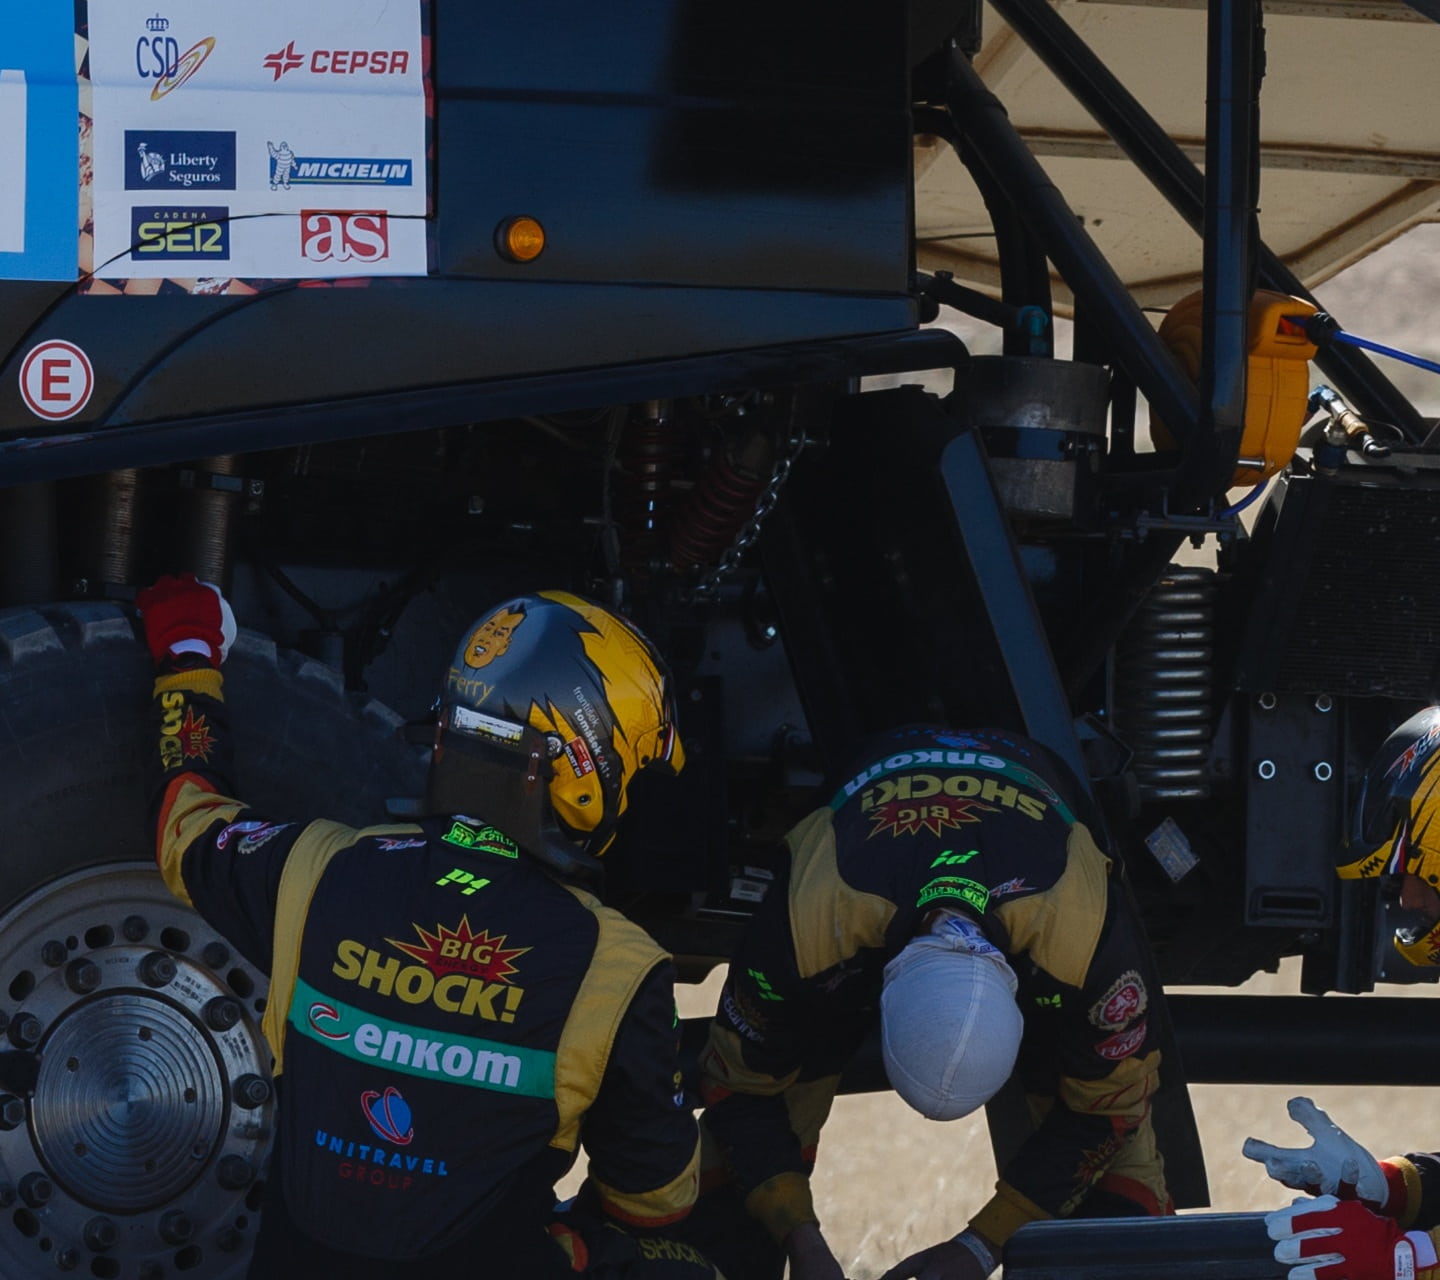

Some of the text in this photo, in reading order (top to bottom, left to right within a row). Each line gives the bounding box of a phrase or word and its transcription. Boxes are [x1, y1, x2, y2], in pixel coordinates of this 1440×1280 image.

[136, 35, 179, 79] CSD
[310, 50, 410, 75] CEPSA
[169, 152, 219, 170] Liberty
[297, 162, 408, 179] MICHELIN
[168, 169, 221, 187] Seguros
[153, 211, 207, 220] CADENA
[137, 222, 223, 253] SER
[305, 213, 386, 263] as
[41, 358, 72, 402] E
[860, 772, 1049, 822] SHOCK!
[896, 804, 951, 825] BIG
[439, 937, 495, 965] BIG
[332, 938, 526, 1025] SHOCK!
[353, 1022, 523, 1089] enkom
[314, 1128, 449, 1177] UNITRAVEL
[336, 1161, 415, 1191] GROUP
